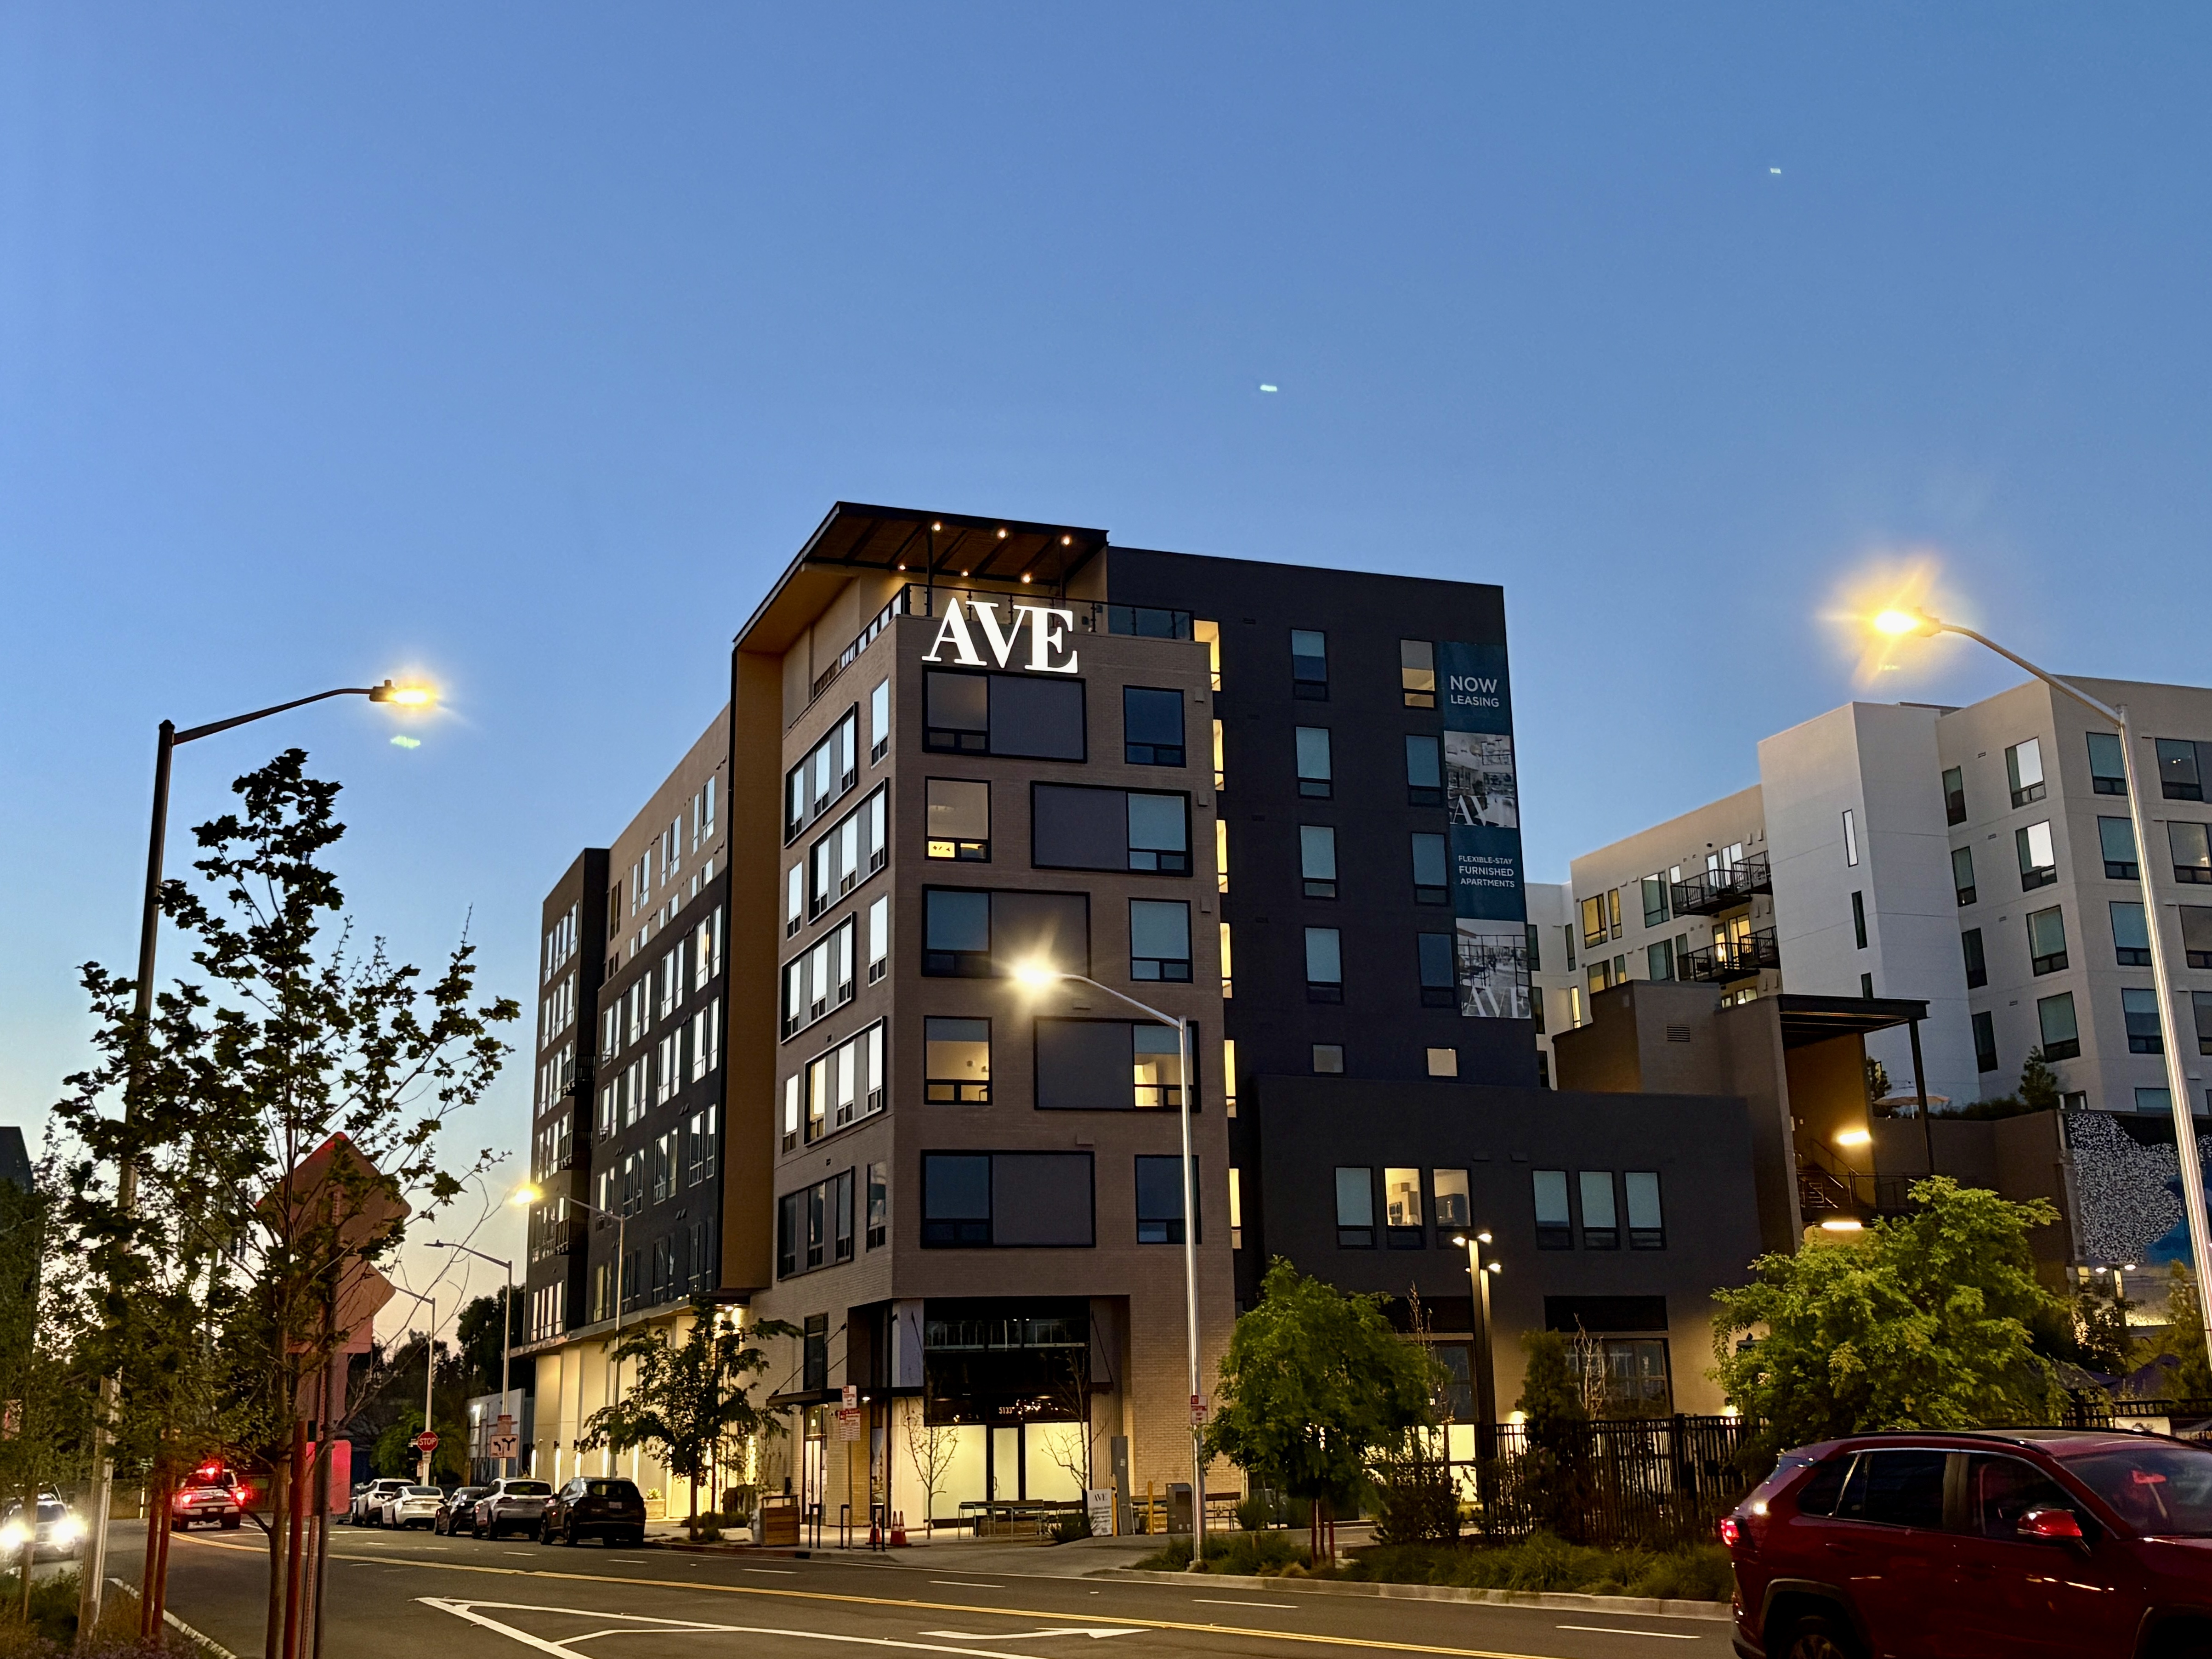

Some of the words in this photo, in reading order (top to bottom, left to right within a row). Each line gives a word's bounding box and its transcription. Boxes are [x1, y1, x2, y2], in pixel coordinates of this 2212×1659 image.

[921, 597, 1078, 674] AVE
[1450, 675, 1497, 694] NOW
[1450, 694, 1499, 708] LEASING
[1458, 855, 1513, 865] FLEXIBLE-STAY
[1459, 866, 1514, 877] FURNISHED
[1460, 878, 1515, 888] APARTMENTS
[1462, 985, 1532, 1019] AVE
[419, 1437, 437, 1446] STOP
